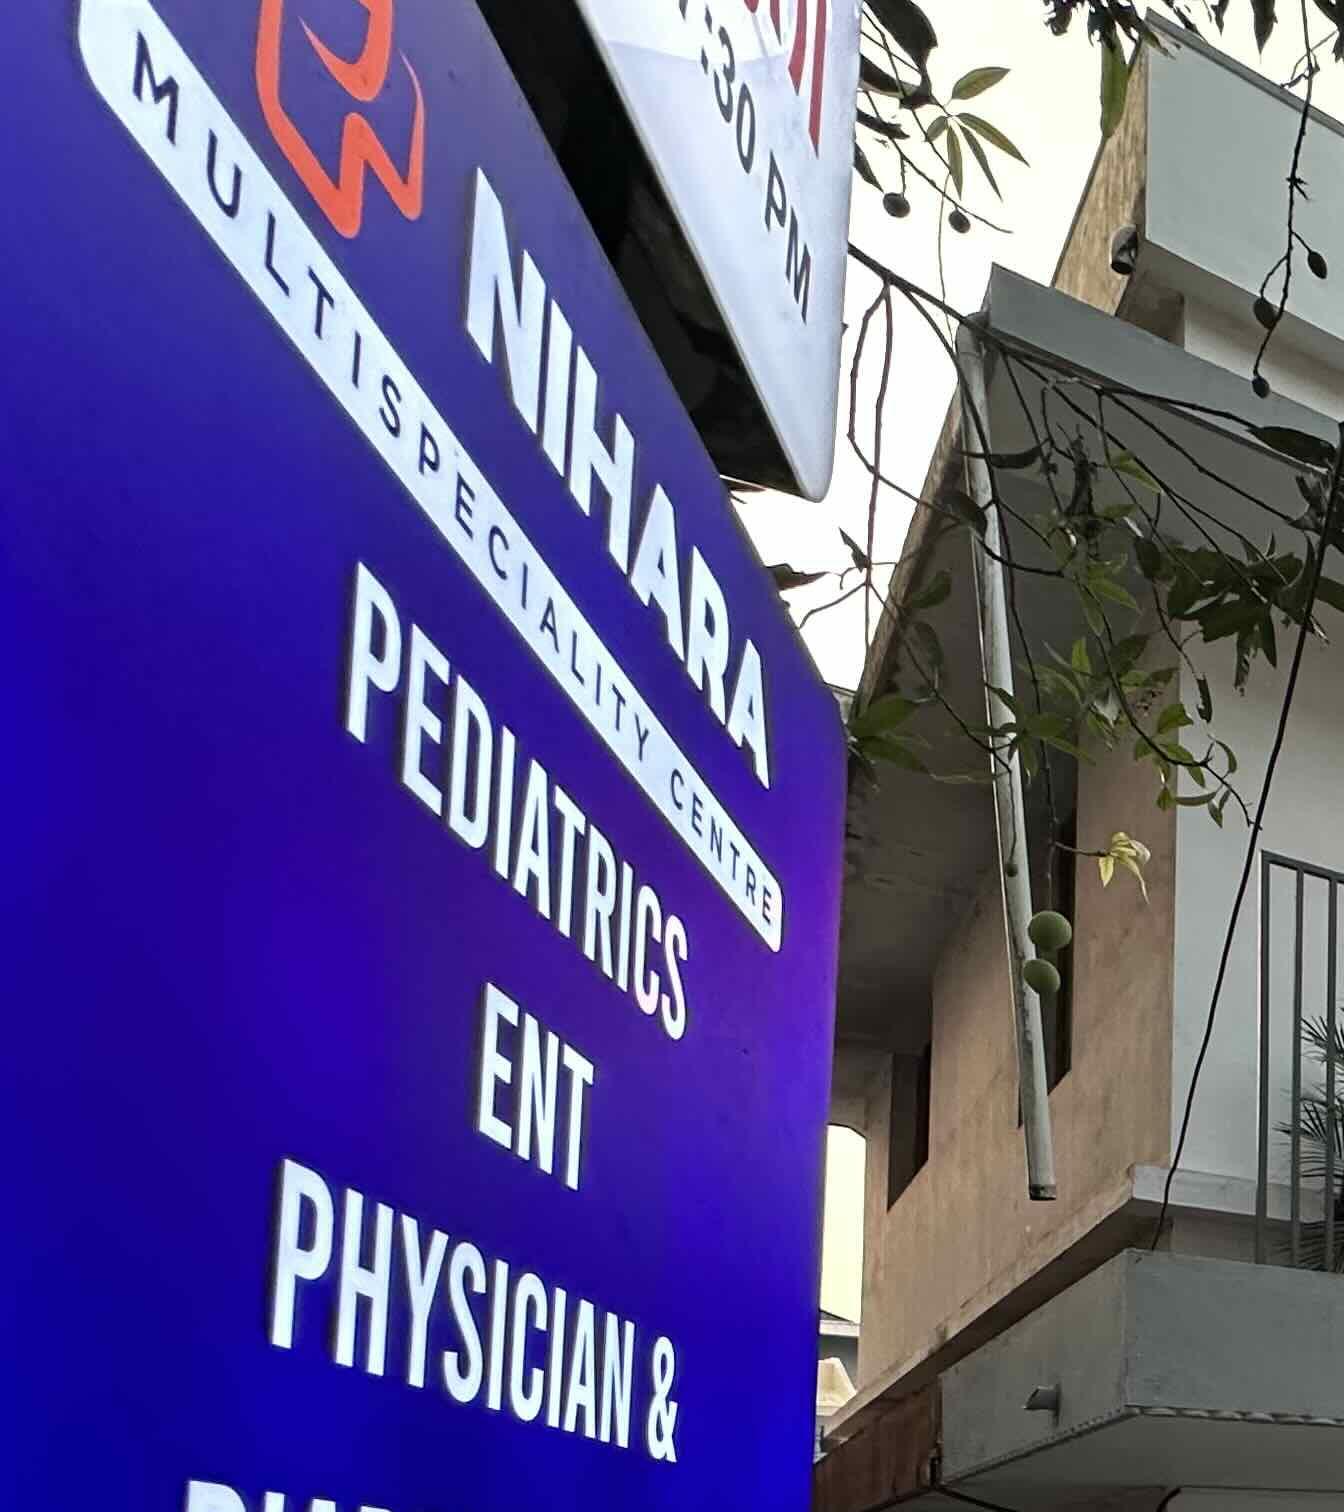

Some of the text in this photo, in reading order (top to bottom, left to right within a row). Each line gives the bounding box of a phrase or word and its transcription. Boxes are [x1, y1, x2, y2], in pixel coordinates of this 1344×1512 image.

[679, 0, 758, 174] :30
[765, 149, 811, 325] PM
[134, 31, 776, 930] MULTISPECIALITY CENTRE
[466, 167, 771, 788] NIHARA
[344, 561, 688, 1040] PEDIATRICS
[477, 983, 594, 1190] ENT
[268, 1158, 679, 1463] PHYSICIAN &
